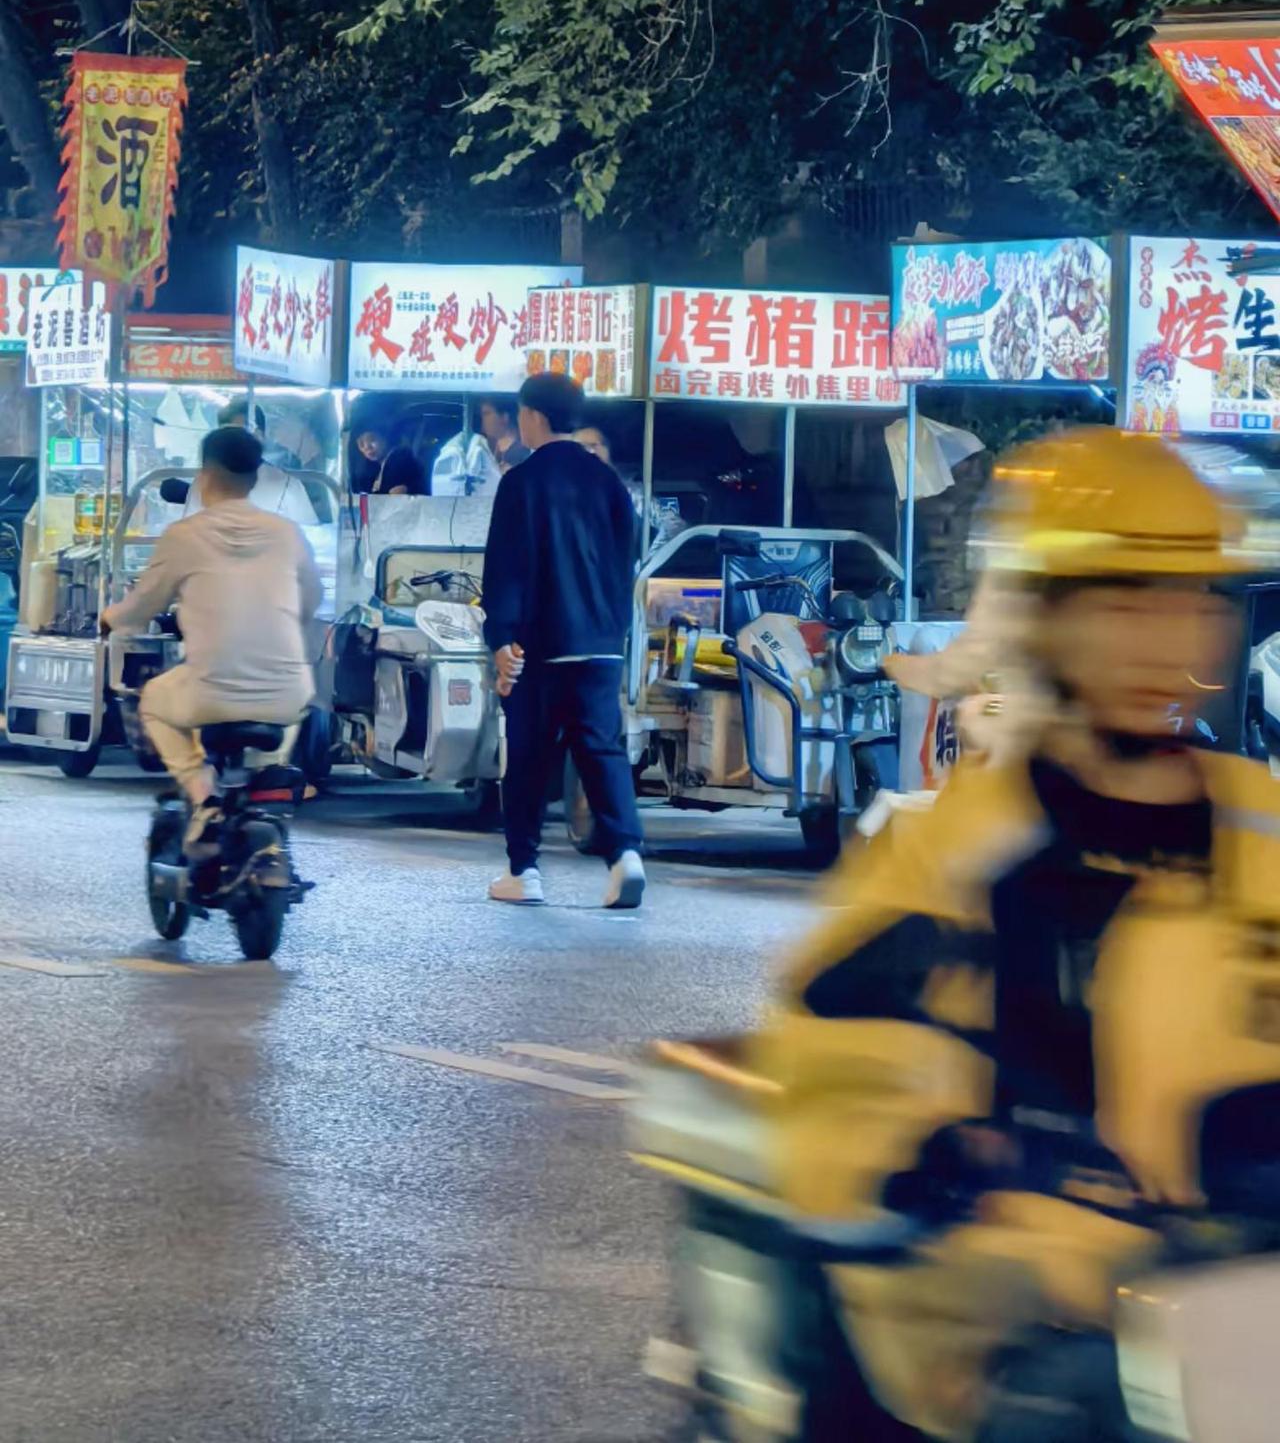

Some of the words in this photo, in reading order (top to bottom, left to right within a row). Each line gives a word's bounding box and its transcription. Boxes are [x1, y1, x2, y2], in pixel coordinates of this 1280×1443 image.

[96, 115, 158, 210] 酒
[657, 290, 892, 371] 烤猪蹄
[655, 368, 775, 398] 卤完再烤
